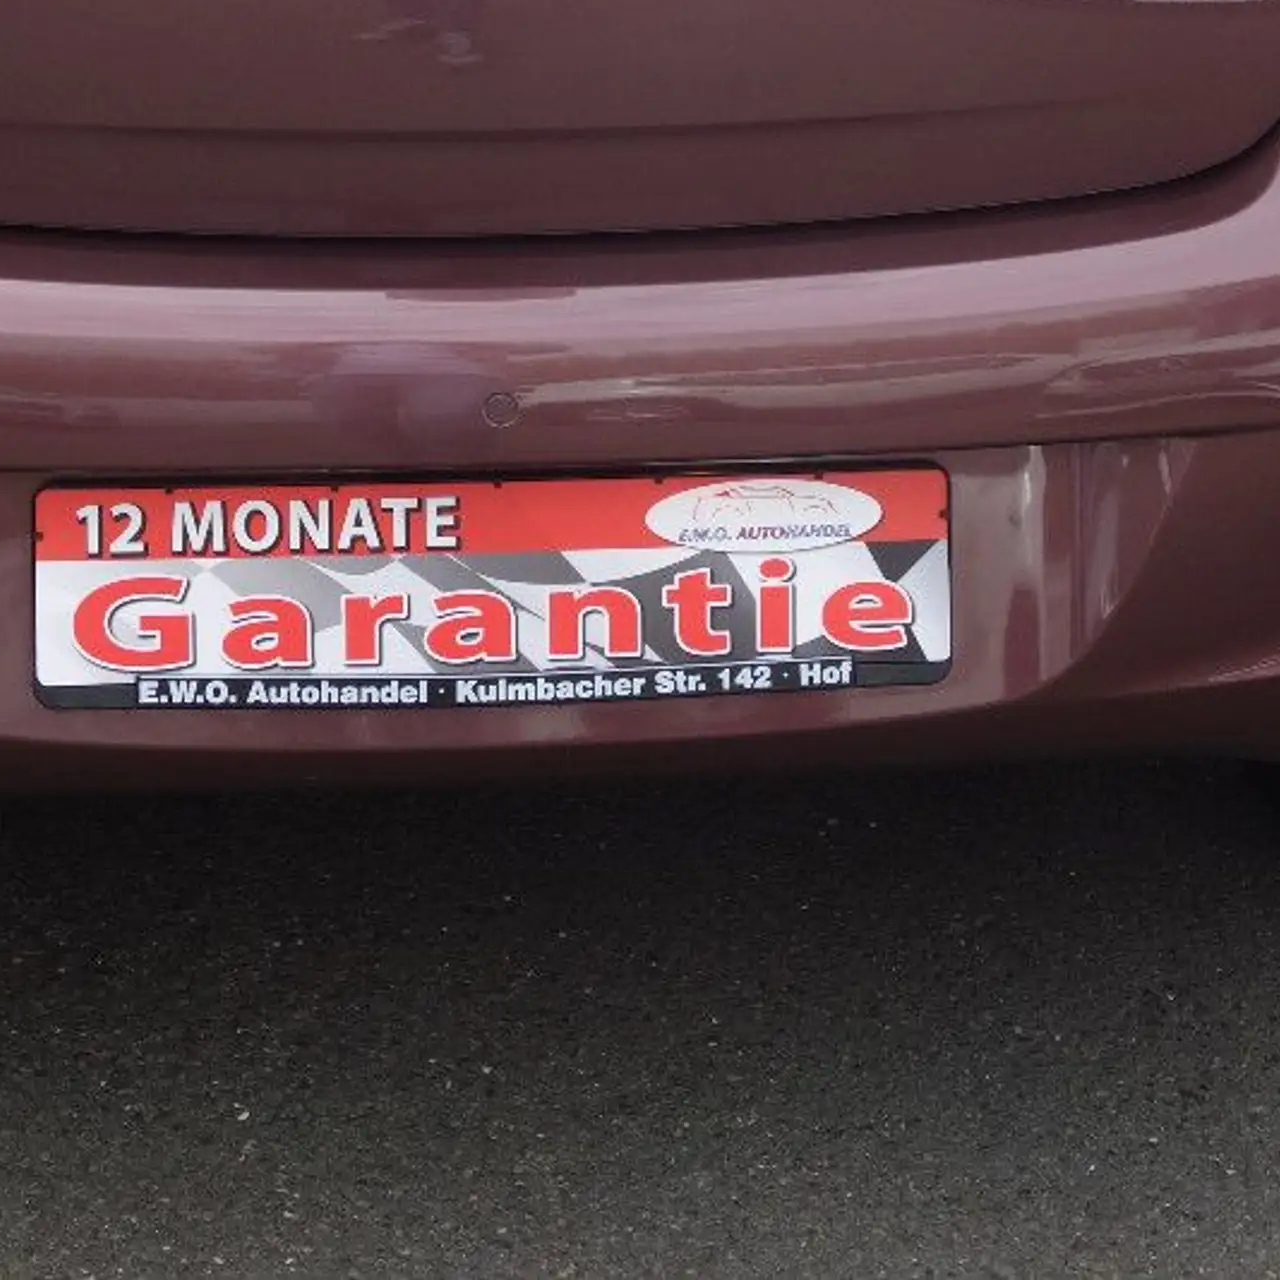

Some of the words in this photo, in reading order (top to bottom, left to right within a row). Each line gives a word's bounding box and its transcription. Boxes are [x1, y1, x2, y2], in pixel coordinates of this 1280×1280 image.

[75, 502, 148, 558] 12
[170, 496, 460, 554] MONATE
[735, 523, 851, 542] AUTOHANDEL
[71, 555, 916, 674] Garantie
[138, 679, 237, 705] E.W.O.
[247, 679, 428, 705] Autohandel
[455, 675, 646, 704] Kulmbacher
[654, 667, 706, 694] Str.
[718, 665, 773, 689] 142
[800, 661, 853, 686] Hof
